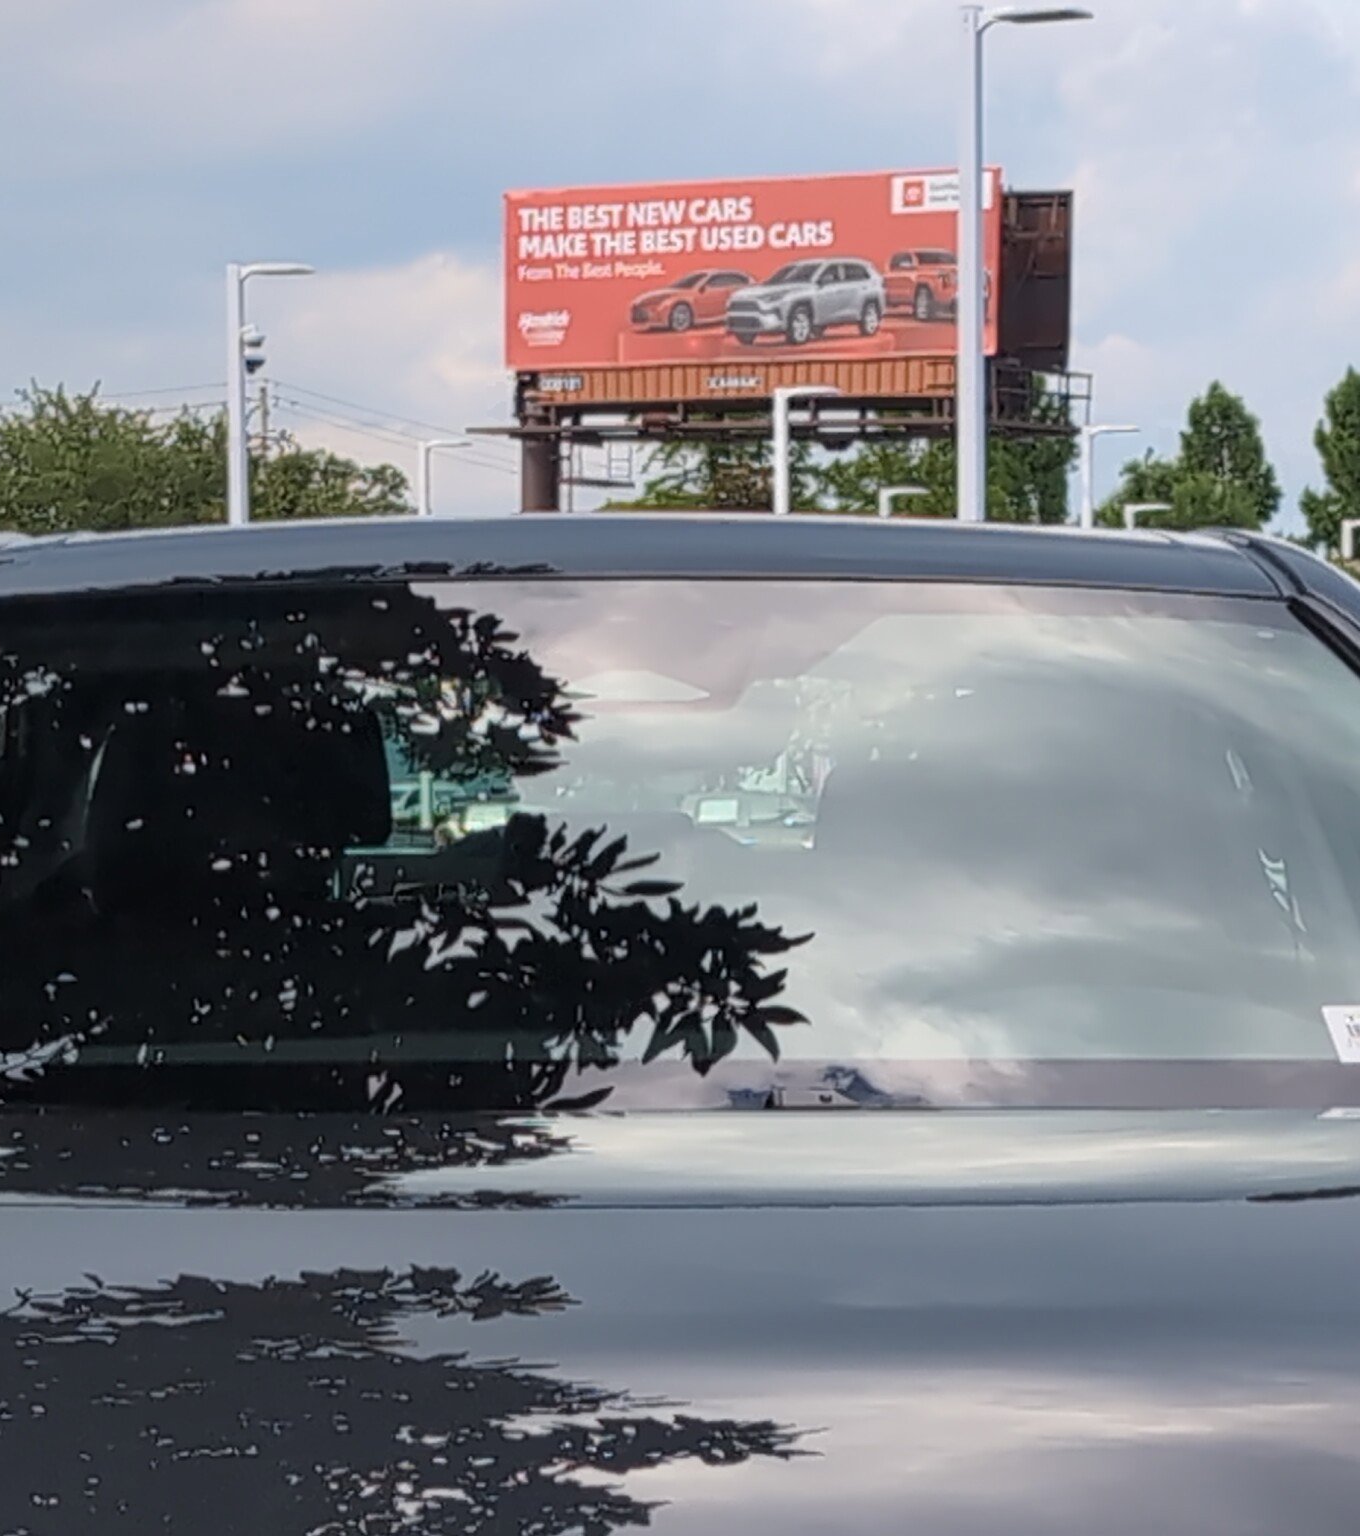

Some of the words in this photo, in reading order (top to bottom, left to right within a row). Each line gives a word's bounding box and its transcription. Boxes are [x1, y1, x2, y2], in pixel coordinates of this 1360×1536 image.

[518, 206, 564, 232] THE
[567, 204, 623, 230] BEST
[626, 200, 687, 228] NEW
[688, 196, 753, 224] CARS
[518, 233, 588, 259] MAKE
[591, 230, 636, 257] THE
[639, 227, 698, 254] BEST
[700, 225, 765, 251] USED
[767, 220, 834, 249] CARS
[555, 262, 580, 280] The
[582, 261, 612, 279] Best
